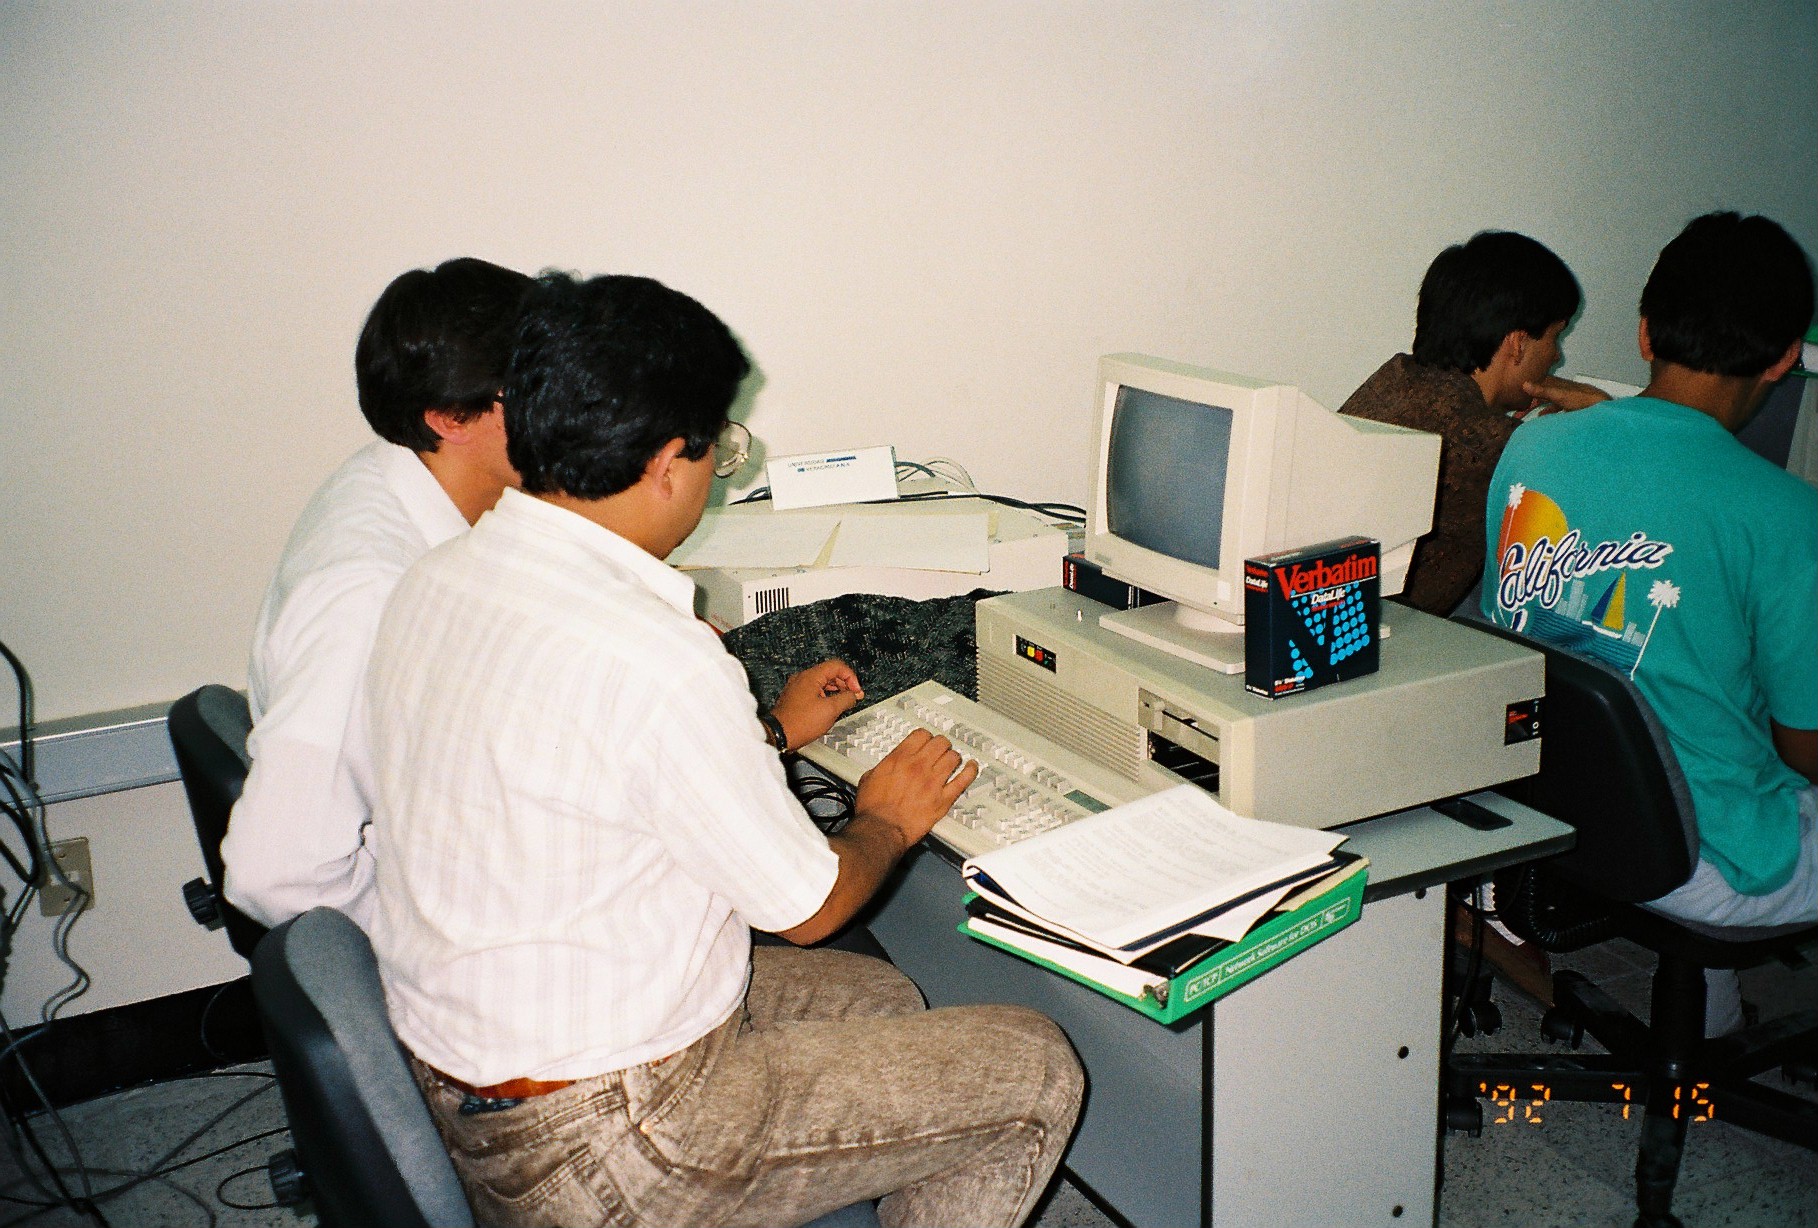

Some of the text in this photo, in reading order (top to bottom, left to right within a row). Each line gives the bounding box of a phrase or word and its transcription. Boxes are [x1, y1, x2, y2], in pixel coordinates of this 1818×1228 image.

[1274, 554, 1377, 601] Verbatim
[1497, 529, 1673, 611] California
[1311, 587, 1346, 605] DataLife
